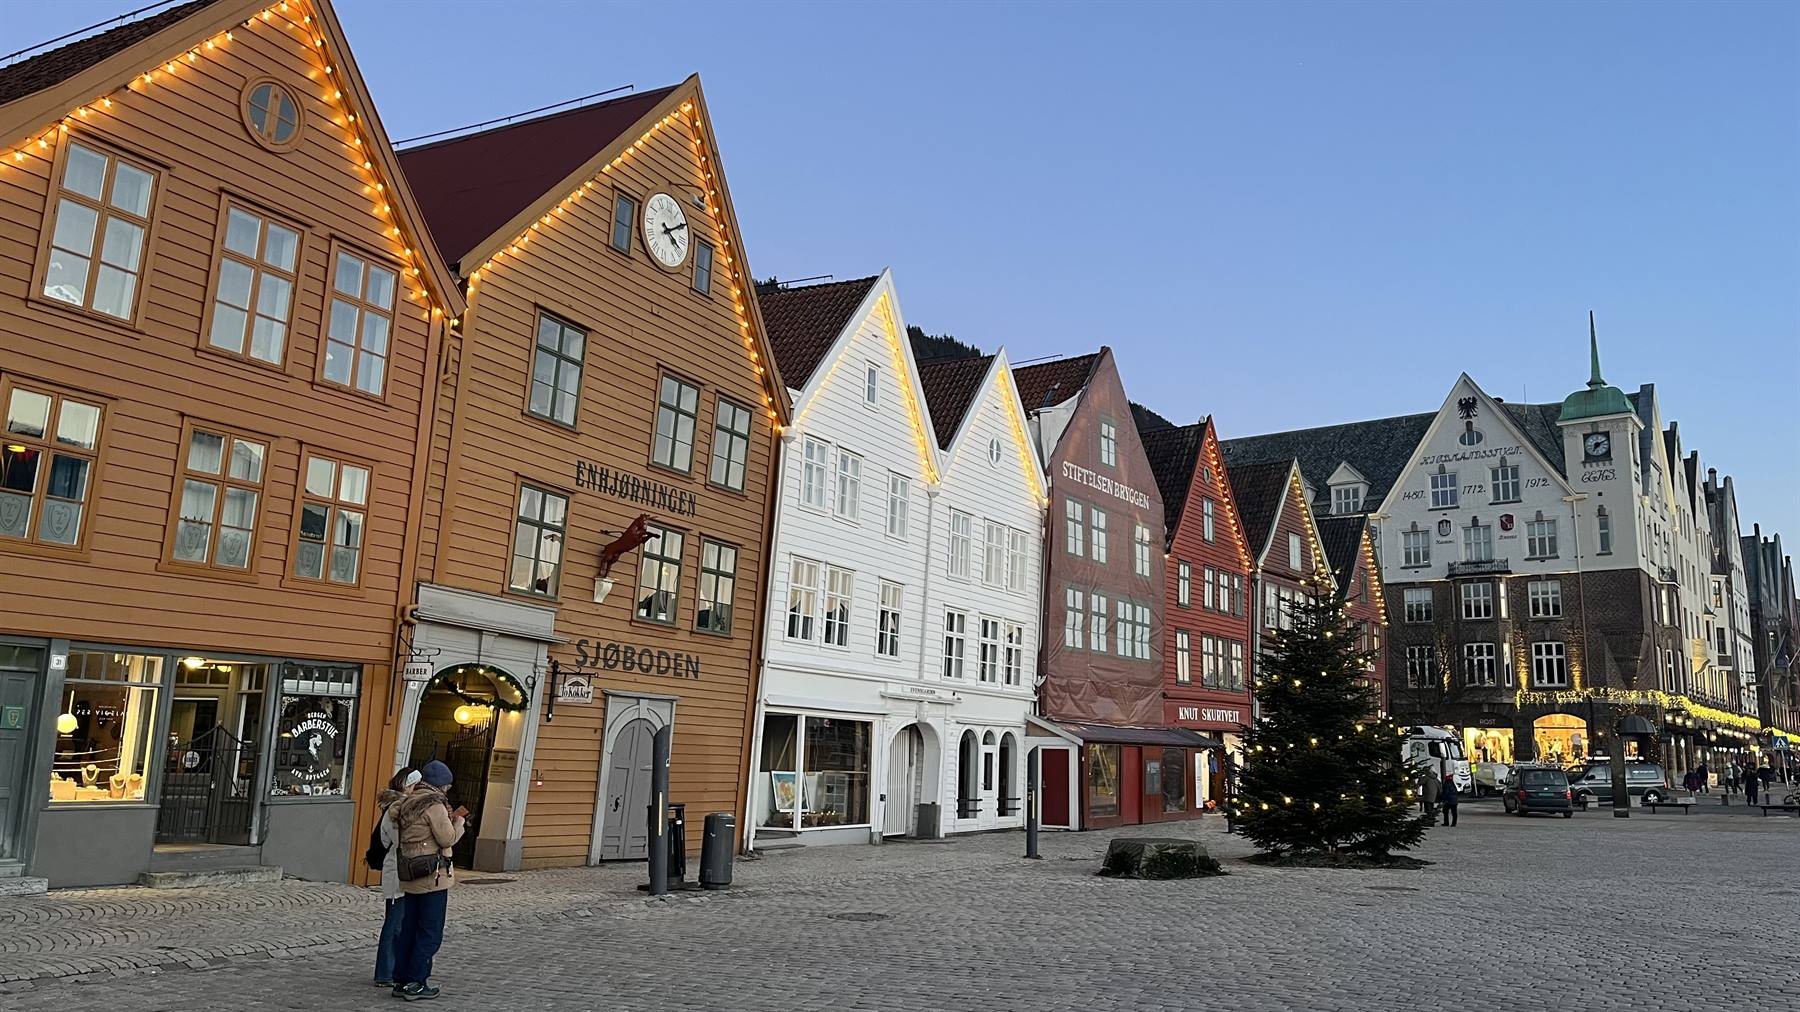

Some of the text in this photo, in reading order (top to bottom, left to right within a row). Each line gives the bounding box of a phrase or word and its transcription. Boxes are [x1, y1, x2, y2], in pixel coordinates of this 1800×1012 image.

[575, 460, 697, 518] ENHJØRNINGEN
[1062, 460, 1150, 510] STIFTELSEN BRYGGEN
[575, 639, 700, 679] SJØBODEN
[291, 718, 339, 739] BARBERSTUE
[1178, 707, 1240, 723] KNUT SKURTVEIT
